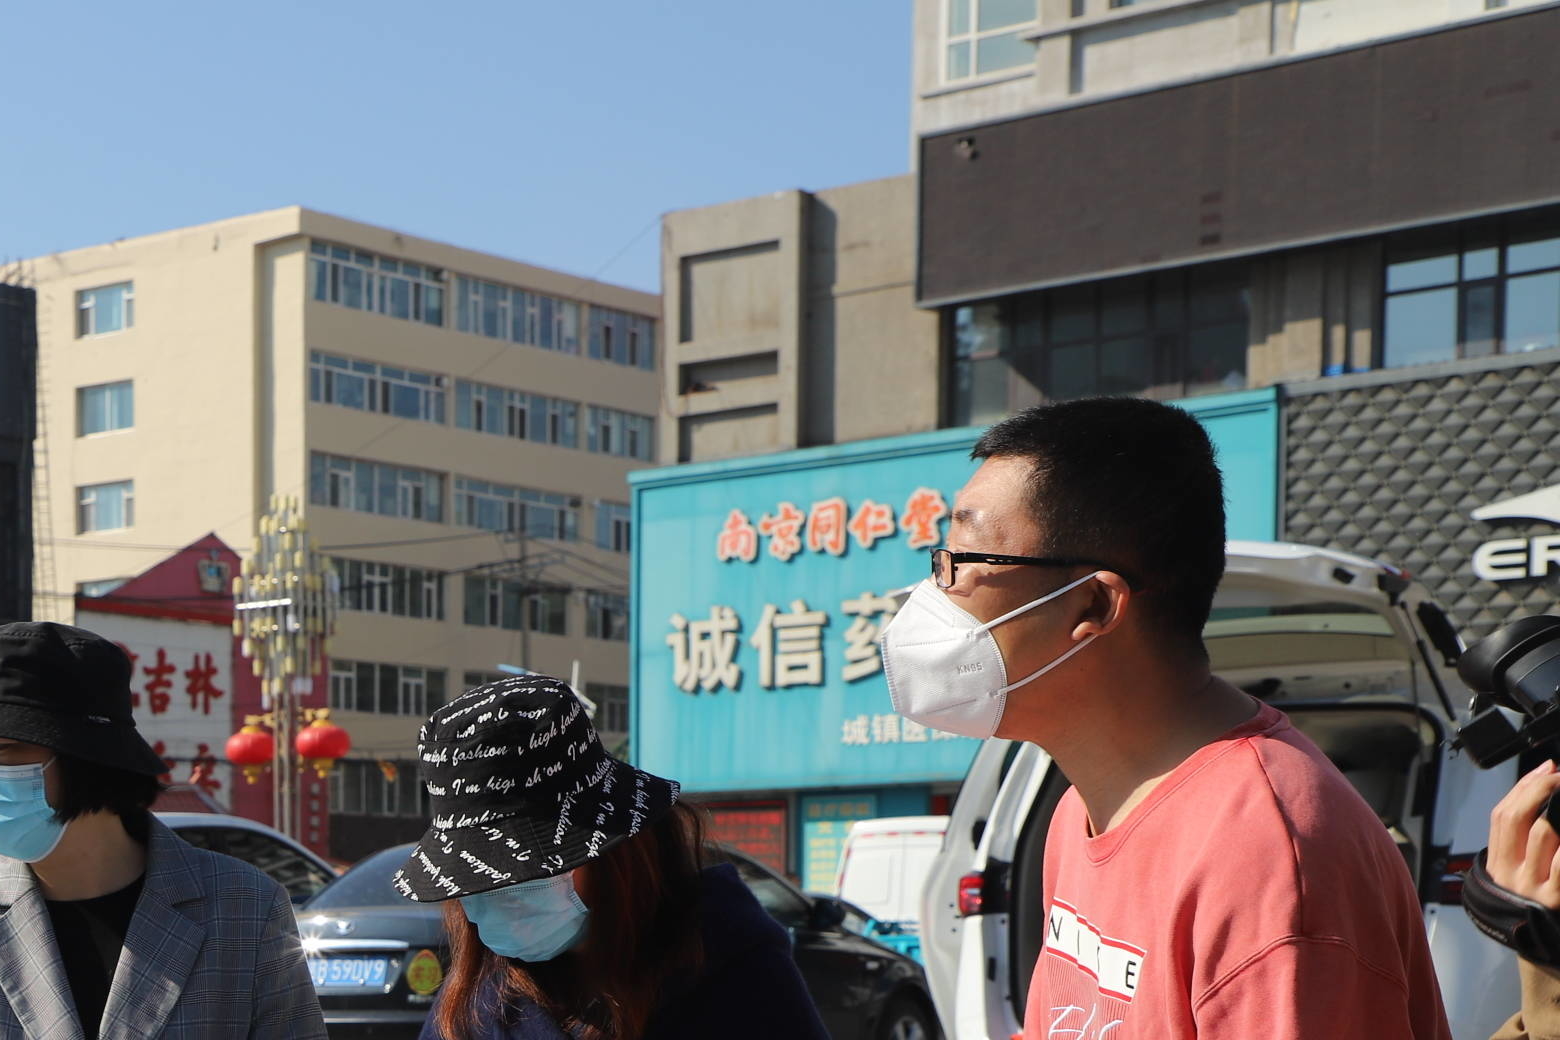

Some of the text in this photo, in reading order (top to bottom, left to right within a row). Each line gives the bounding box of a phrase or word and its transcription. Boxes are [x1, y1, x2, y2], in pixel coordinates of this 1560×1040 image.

[716, 486, 947, 562] 南京同仁堂
[956, 662, 983, 676] KN95
[452, 743, 508, 766] fashion
